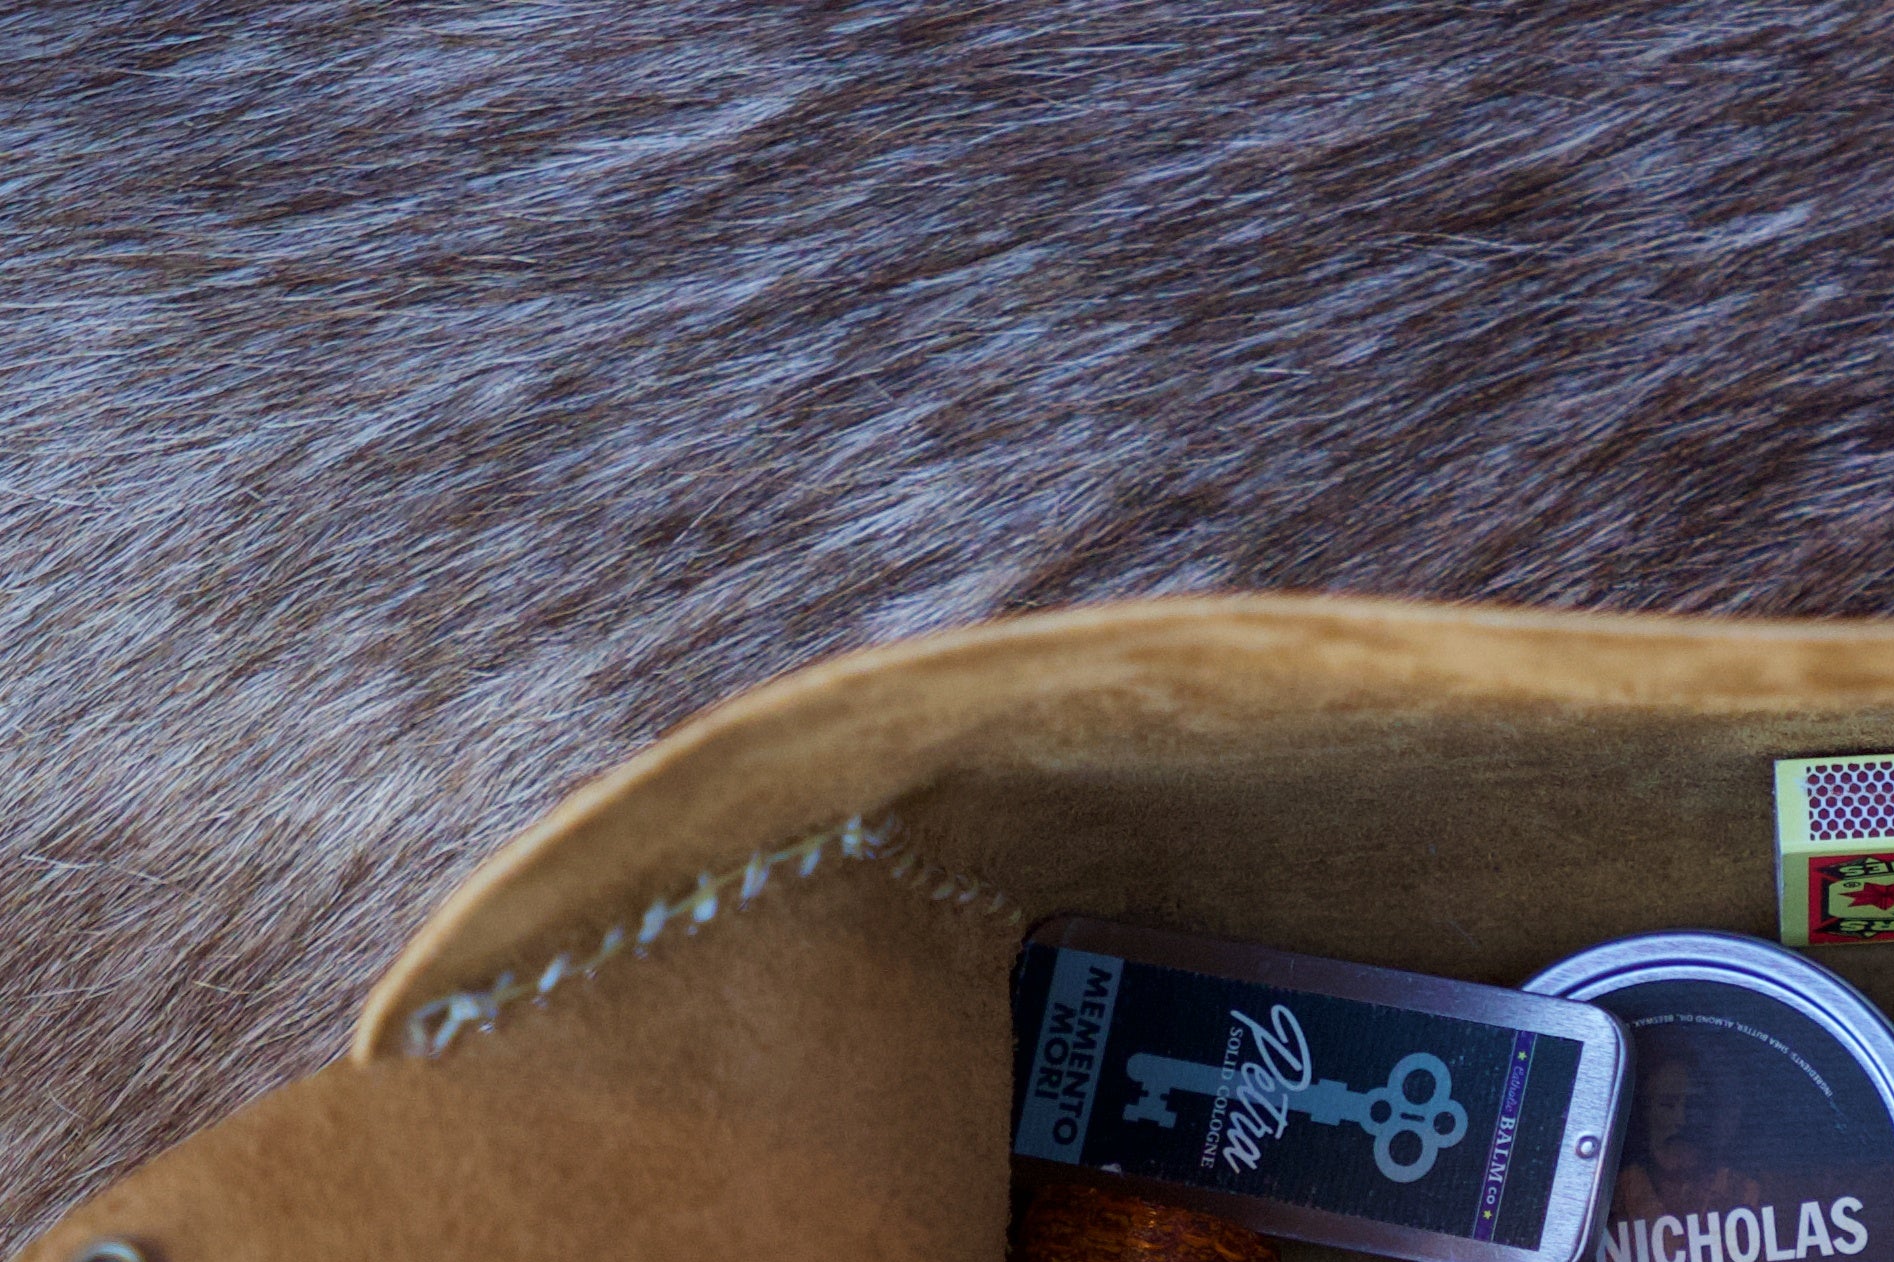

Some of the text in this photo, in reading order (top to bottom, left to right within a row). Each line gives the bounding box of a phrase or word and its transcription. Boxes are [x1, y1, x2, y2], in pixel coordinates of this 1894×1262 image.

[1034, 1002, 1076, 1100] MORI
[1052, 965, 1113, 1146] MEMENTO
[1201, 1026, 1243, 1169] SOLID COLOGNE
[1222, 1003, 1312, 1174] Petra
[1487, 1115, 1516, 1183] BALM
